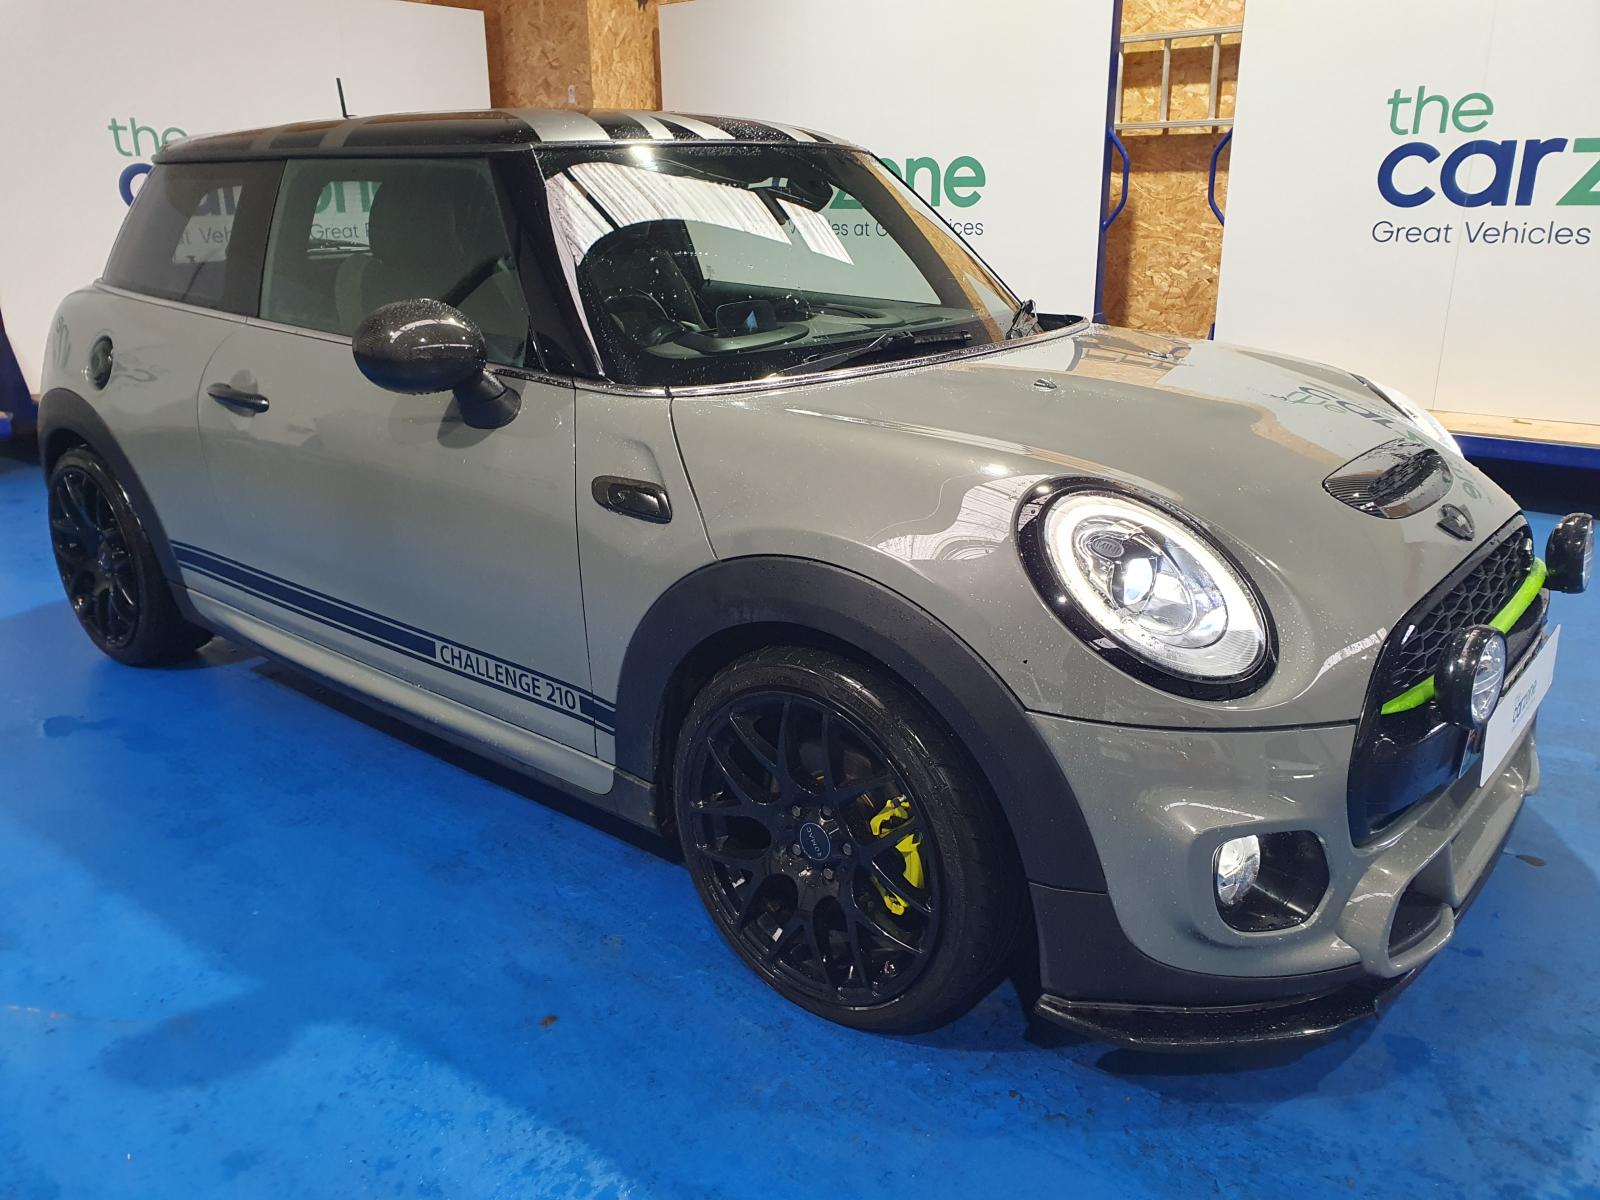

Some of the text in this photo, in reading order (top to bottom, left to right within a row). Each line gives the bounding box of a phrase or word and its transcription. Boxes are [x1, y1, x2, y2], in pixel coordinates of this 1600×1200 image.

[1387, 84, 1494, 136] the
[311, 223, 360, 240] Great
[853, 221, 870, 236] at
[1371, 220, 1591, 245] Great Vehicles
[439, 644, 577, 711] CHALLENGE 210
